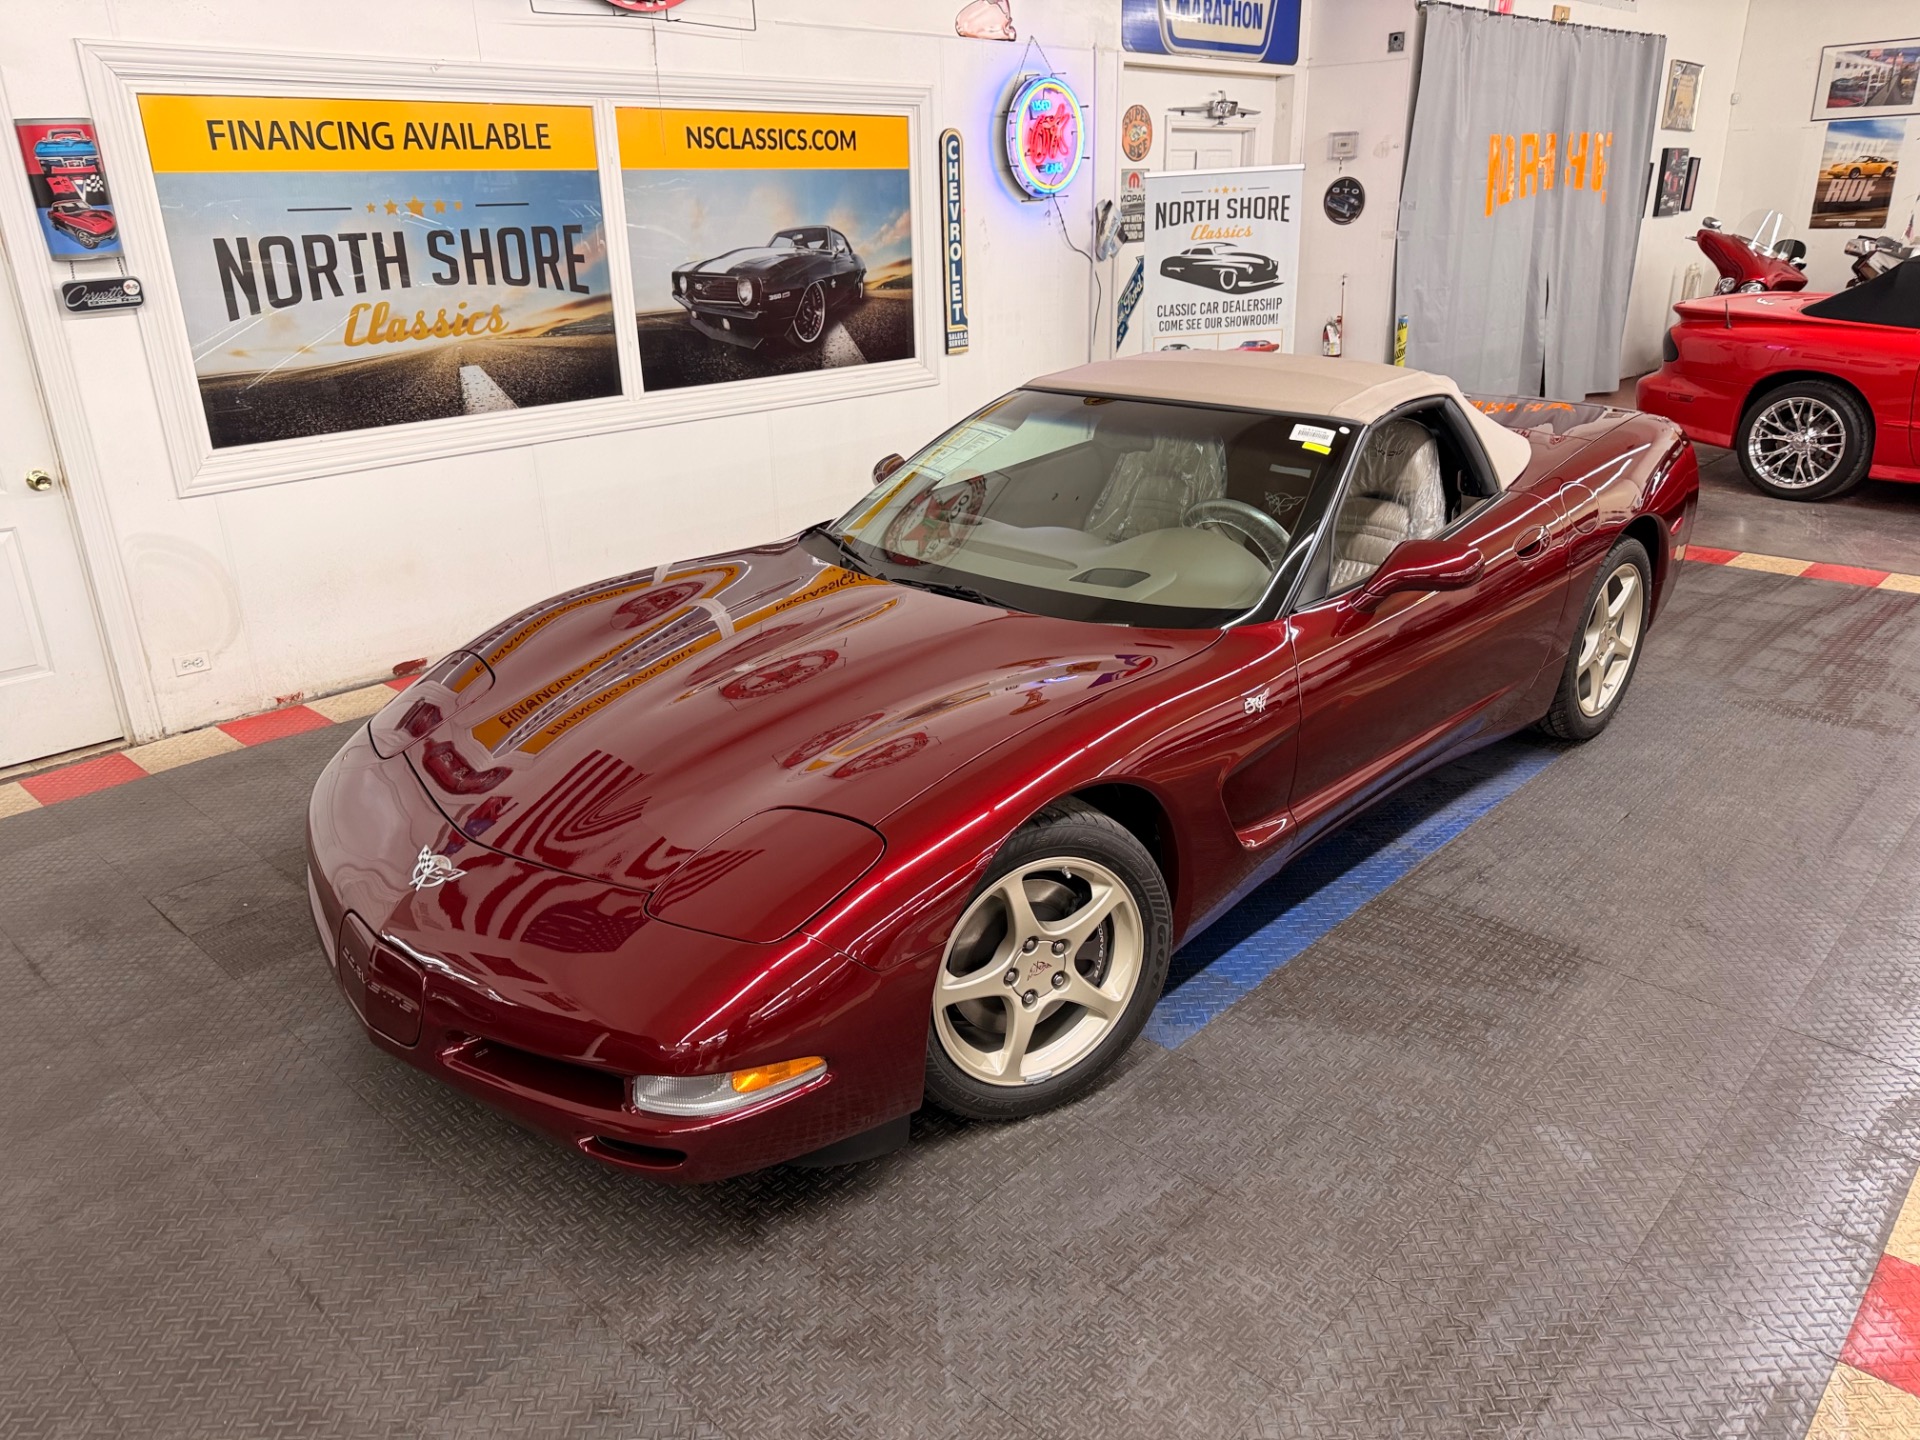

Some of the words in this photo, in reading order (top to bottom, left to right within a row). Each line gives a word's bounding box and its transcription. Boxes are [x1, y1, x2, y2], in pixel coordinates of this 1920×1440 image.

[1175, 0, 1264, 30] MARATHON
[1124, 106, 1150, 131] SUPER
[206, 119, 394, 152] FINANCING
[402, 122, 552, 151] AVAILABLE
[685, 126, 857, 152] NSCLASSICS.COM
[1128, 138, 1149, 159] BEE
[1331, 187, 1360, 195] GTO
[1823, 178, 1880, 203] RIDE
[1155, 198, 1220, 231] NORTH
[1226, 195, 1291, 223] SHORE
[947, 140, 964, 321] CHEVROLET
[1190, 224, 1253, 241] Classics
[213, 230, 411, 322] NORTH
[427, 225, 590, 294] SHORE
[65, 284, 127, 308] Corvette
[1156, 302, 1197, 318] CLASSIC
[1199, 301, 1219, 315] CAR
[1222, 297, 1283, 313] DEALERSHIP
[344, 301, 510, 347] Classics
[1158, 319, 1184, 332] COME
[1185, 318, 1202, 331] SEE
[1204, 316, 1222, 329] OUR
[1224, 313, 1279, 328] SHOWROOM!
[948, 332, 963, 340] SALES
[948, 339, 968, 347] SERVICE
